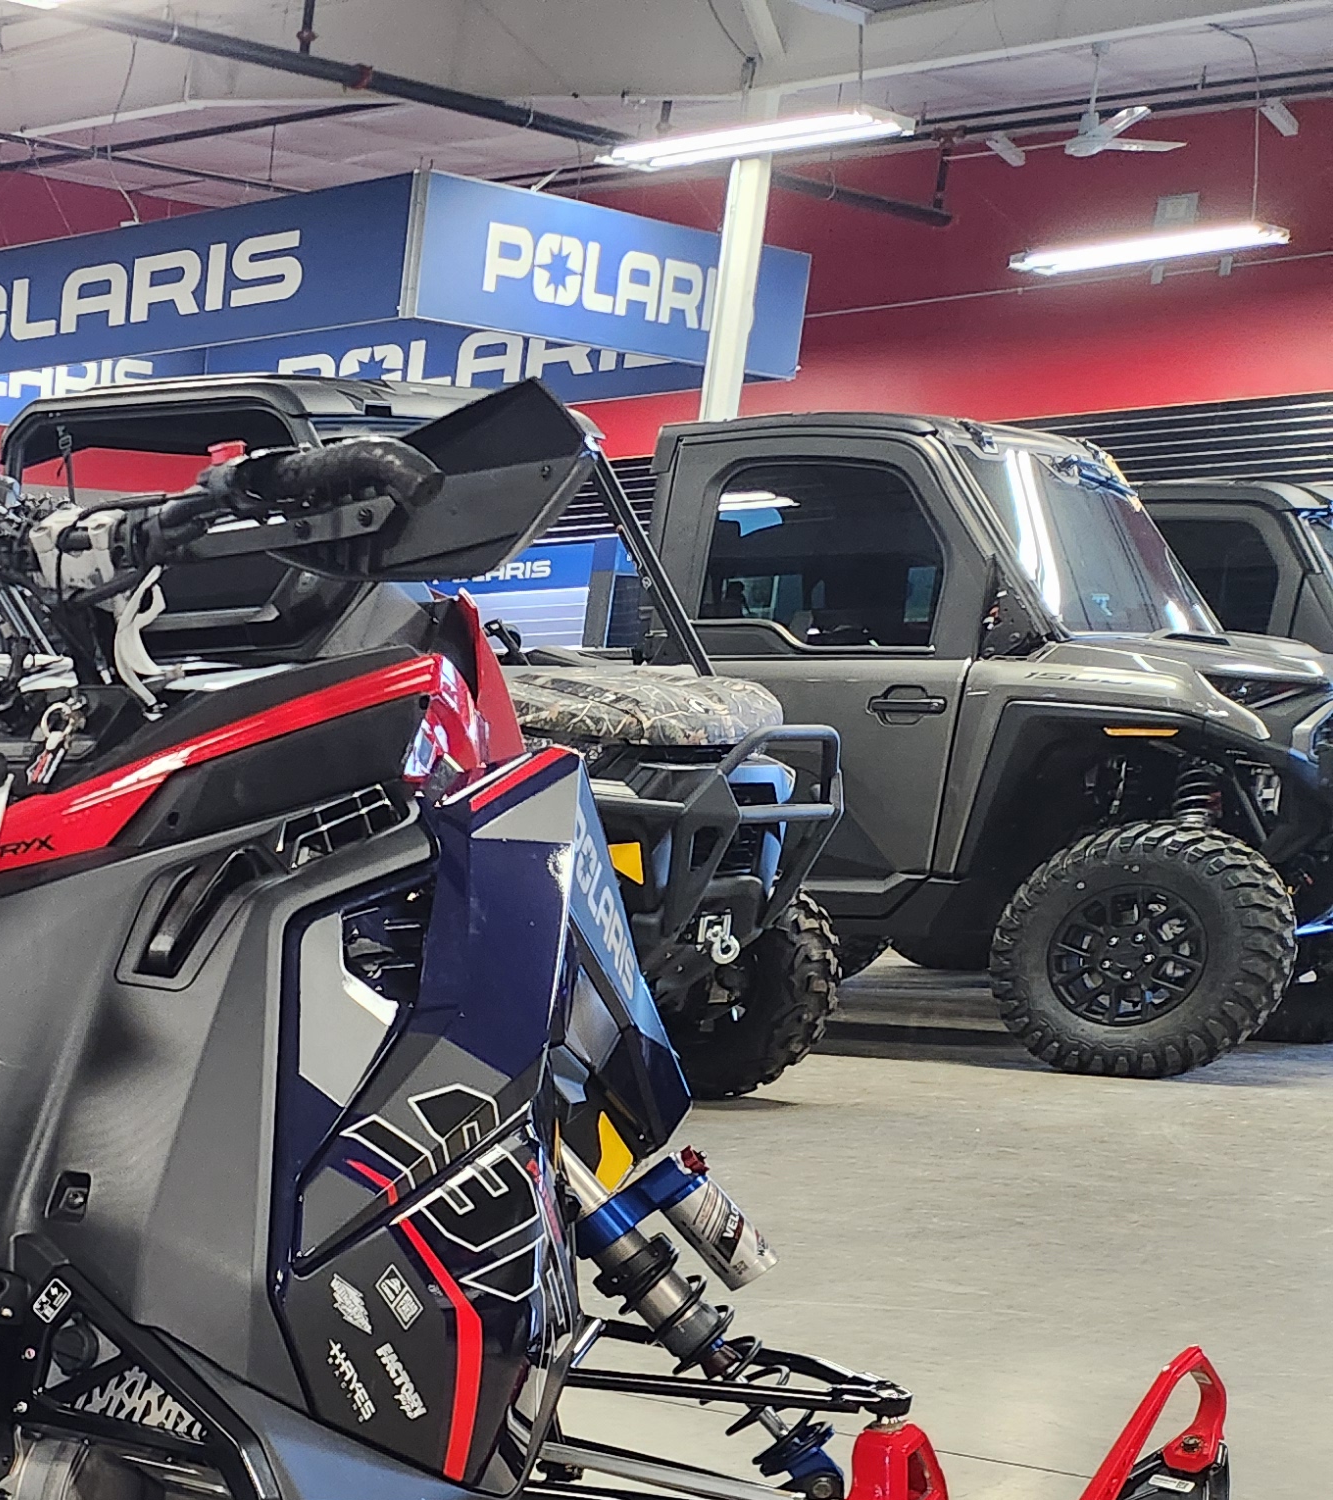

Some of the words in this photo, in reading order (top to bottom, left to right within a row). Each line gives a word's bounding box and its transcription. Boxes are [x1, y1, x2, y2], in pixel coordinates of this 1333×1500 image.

[482, 221, 753, 340] POLARI
[575, 803, 635, 1000] POLARIS
[328, 1338, 376, 1421] HAYES
[375, 1342, 428, 1416] FACTORY
